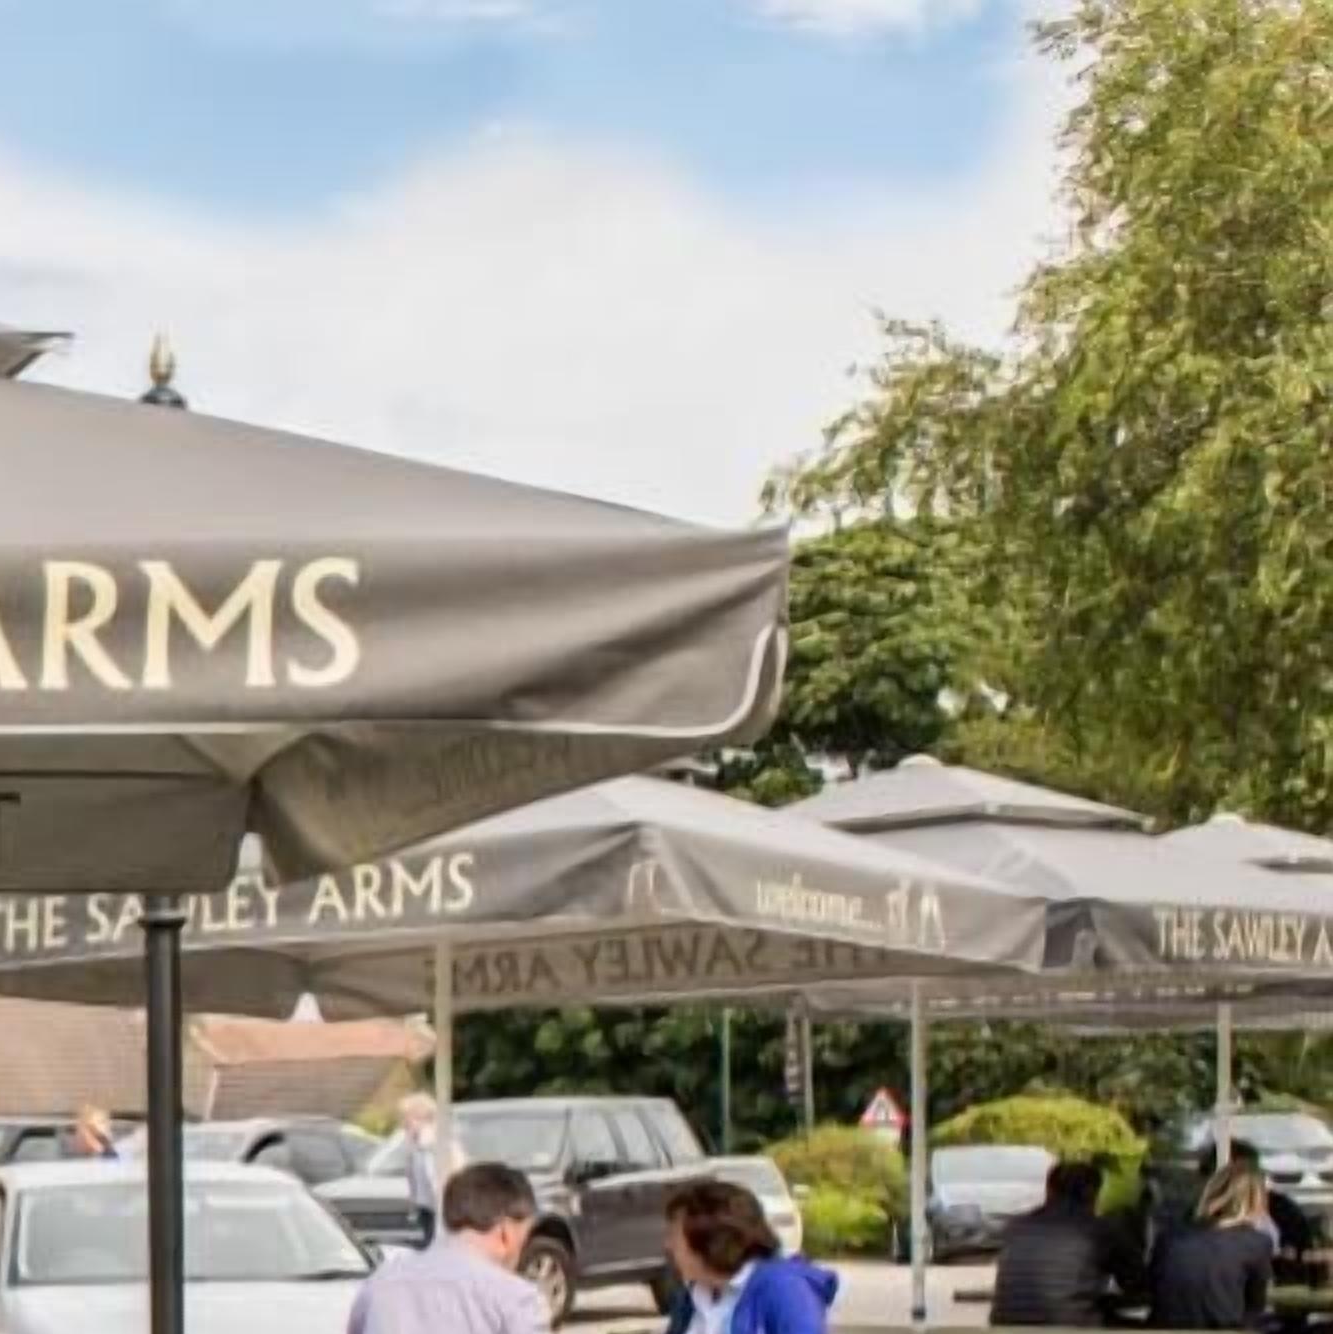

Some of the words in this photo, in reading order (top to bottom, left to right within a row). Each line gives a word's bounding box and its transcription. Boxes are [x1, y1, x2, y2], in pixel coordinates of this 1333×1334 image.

[307, 852, 475, 924] ARMS
[1152, 906, 1207, 960] THE
[1212, 908, 1307, 962] SAWLEY
